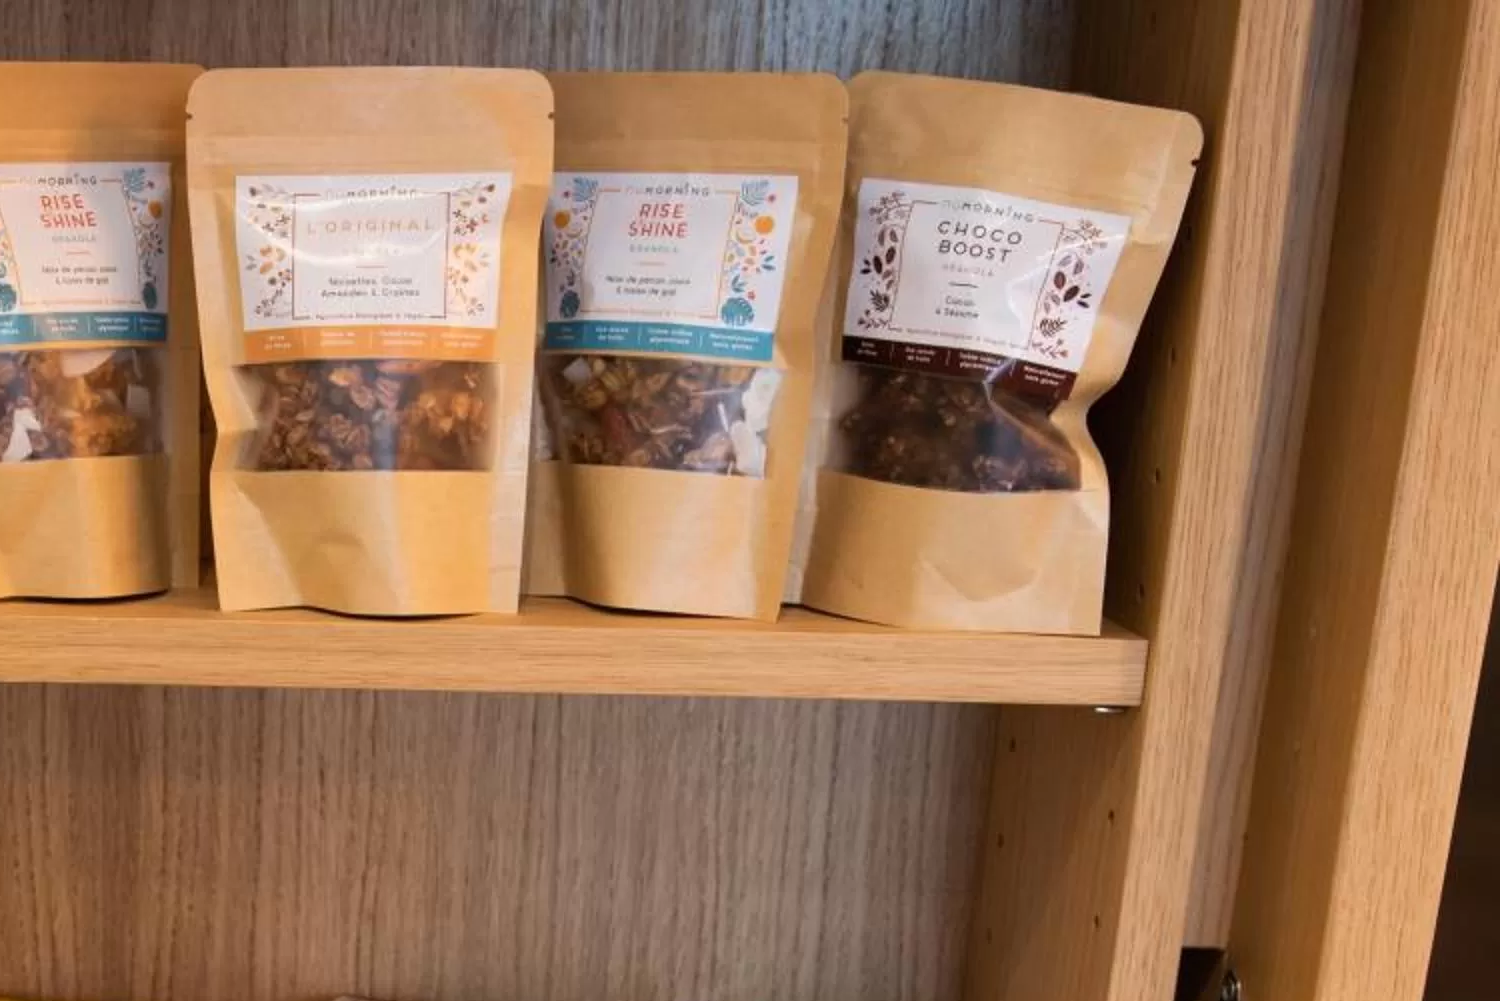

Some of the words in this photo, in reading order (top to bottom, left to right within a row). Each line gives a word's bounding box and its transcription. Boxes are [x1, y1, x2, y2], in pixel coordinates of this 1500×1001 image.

[39, 193, 84, 211] RISE
[40, 211, 97, 228] SHINE
[640, 203, 685, 219] RISE
[627, 221, 688, 237] SHINE
[937, 221, 1022, 245] CHOCO
[938, 239, 1012, 262] BOOST
